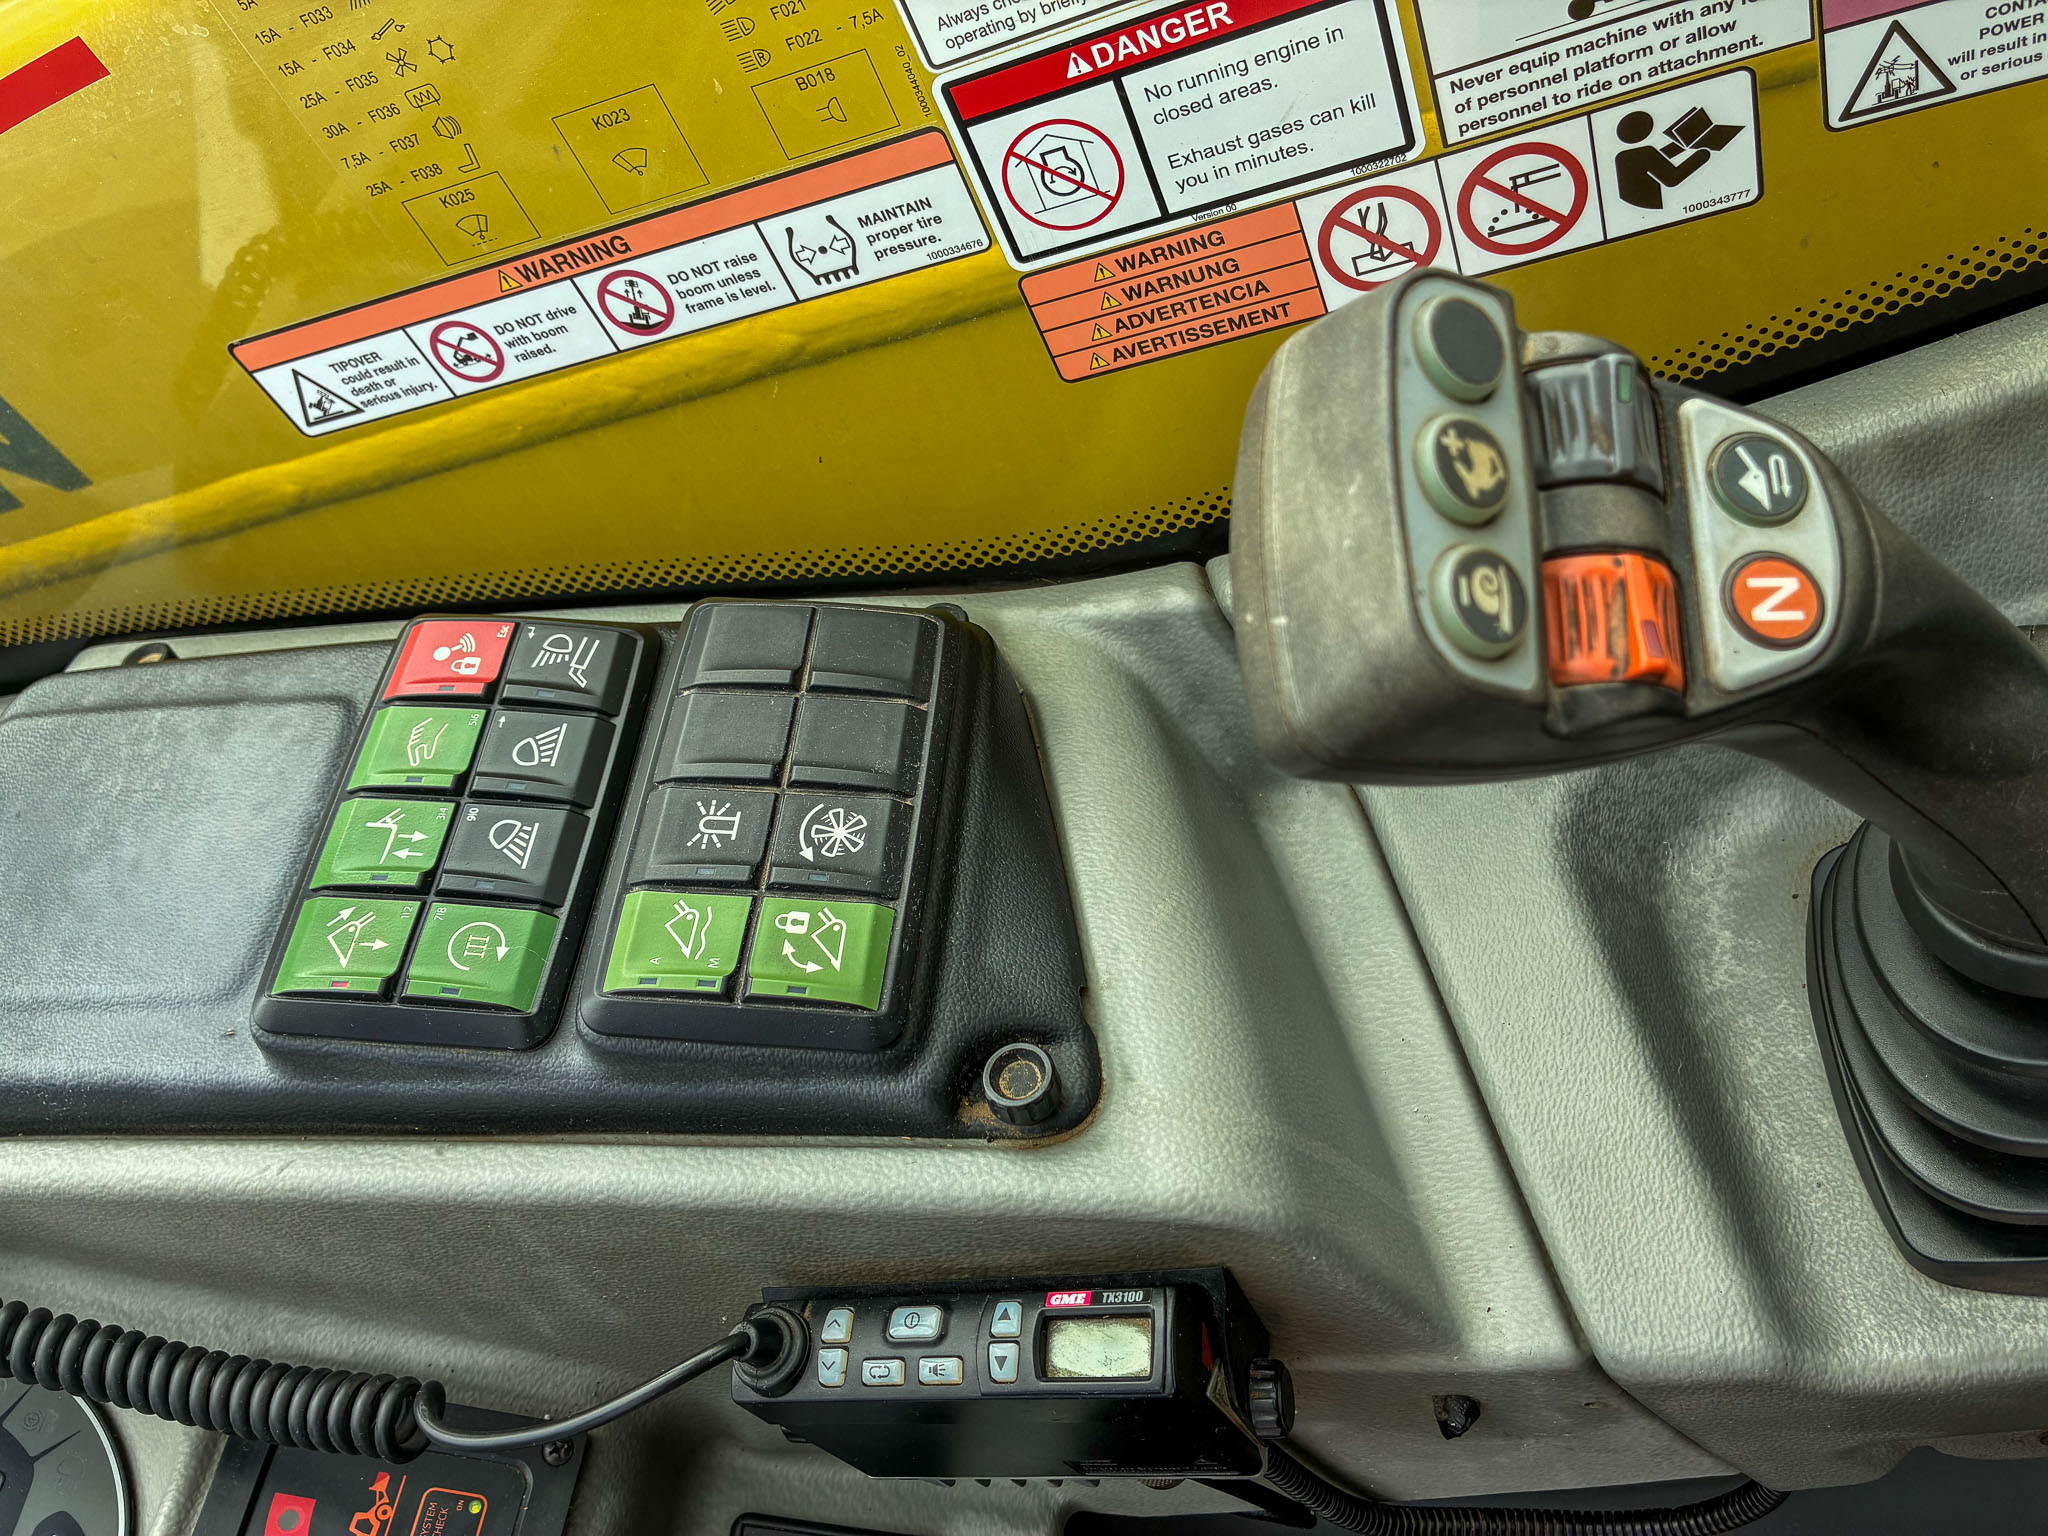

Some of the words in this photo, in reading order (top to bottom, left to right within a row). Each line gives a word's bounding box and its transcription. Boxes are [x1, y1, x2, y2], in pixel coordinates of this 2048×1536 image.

[255, 28, 281, 46] 15A
[299, 6, 333, 28] F033
[770, 0, 806, 20] F021
[937, 2, 990, 31] Always
[945, 16, 1016, 49] operating
[1017, 8, 1036, 23] by
[1039, 0, 1086, 15] brie
[785, 29, 823, 51] F022
[849, 8, 884, 30] 7,5A
[1091, 1, 1234, 68] DANGER
[1979, 13, 2044, 40] POWER
[278, 60, 304, 77] 15A
[322, 39, 356, 60] F034
[1450, 69, 1503, 94] Never
[1508, 51, 1560, 75] equip
[1565, 25, 1647, 58] machine
[1652, 9, 1694, 31] with
[1700, 0, 1735, 18] any
[1948, 49, 1975, 66] will
[1980, 36, 2028, 58] result
[2032, 33, 2047, 44] in
[795, 68, 835, 92] B018
[1144, 84, 1173, 103] No
[1177, 58, 1249, 93] running
[1254, 38, 1320, 71] engine
[1325, 26, 1344, 44] in
[1455, 97, 1472, 114] of
[1477, 68, 1568, 110] personnel
[1573, 45, 1653, 81] platform
[1660, 37, 1680, 52] or
[1685, 20, 1737, 44] allow
[1960, 69, 1977, 80] or
[1981, 52, 2043, 75] serious
[300, 92, 328, 109] 25A
[345, 71, 379, 92] F035
[895, 44, 932, 118] 1000344040_02
[1458, 96, 1548, 137] personnel
[1552, 92, 1571, 106] to
[1577, 80, 1612, 99] ride
[1618, 71, 1642, 86] on
[1648, 34, 1763, 77] attachment.
[1153, 94, 1213, 125] closed
[1218, 77, 1278, 104] areas.
[322, 122, 350, 139] 30A
[368, 103, 400, 123] F036
[592, 108, 630, 130] K023
[1167, 135, 1244, 169] Exhaust
[1247, 118, 1305, 149] gases
[1310, 106, 1345, 126] can
[1350, 93, 1377, 115] kill
[341, 152, 372, 169] 7,5A
[389, 134, 420, 152] F037
[1175, 171, 1210, 194] you
[1212, 165, 1230, 181] in
[1235, 141, 1314, 174] minutes.
[1350, 153, 1407, 176] 1000322702
[366, 181, 392, 197] 25A
[410, 164, 443, 181] F038
[439, 189, 475, 208] K025
[857, 197, 932, 228] MAINTAIN
[1192, 208, 1224, 222] Version
[1225, 203, 1237, 213] 00
[1682, 189, 1751, 214] 1000343777
[866, 223, 913, 246] proper
[916, 215, 942, 229] tire
[514, 235, 632, 283] WARNING
[874, 234, 941, 261] pressure.
[926, 239, 983, 260] 1000334676
[1114, 230, 1226, 273] WARNING
[666, 271, 689, 285] DO
[691, 261, 721, 279] NOT
[723, 252, 758, 269] raise
[675, 282, 710, 300] boom
[712, 268, 761, 288] unless
[1120, 257, 1241, 302] WARNUNG
[685, 296, 725, 315] frame
[727, 292, 739, 304] is
[741, 280, 776, 299] level.
[1115, 280, 1270, 333] ADVERTENCIA
[493, 321, 516, 335] DO
[518, 313, 544, 330] NOT
[547, 304, 577, 320] drive
[1112, 302, 1291, 363] AVERTISSEMENT
[504, 334, 532, 350] with
[534, 324, 569, 341] boom
[328, 351, 382, 373] TIPOVER
[514, 344, 556, 363] raised.
[341, 369, 373, 385] could
[373, 360, 407, 376] result
[405, 357, 420, 367] in
[351, 382, 383, 397] death
[384, 378, 397, 387] or
[360, 391, 402, 408] serious
[400, 382, 438, 396] injury.
[649, 956, 661, 965] A
[706, 957, 720, 968] M
[1050, 1293, 1086, 1304] GME
[1102, 1291, 1143, 1303] TX3100
[420, 1502, 437, 1536] YSTEM
[456, 1499, 464, 1511] ON
